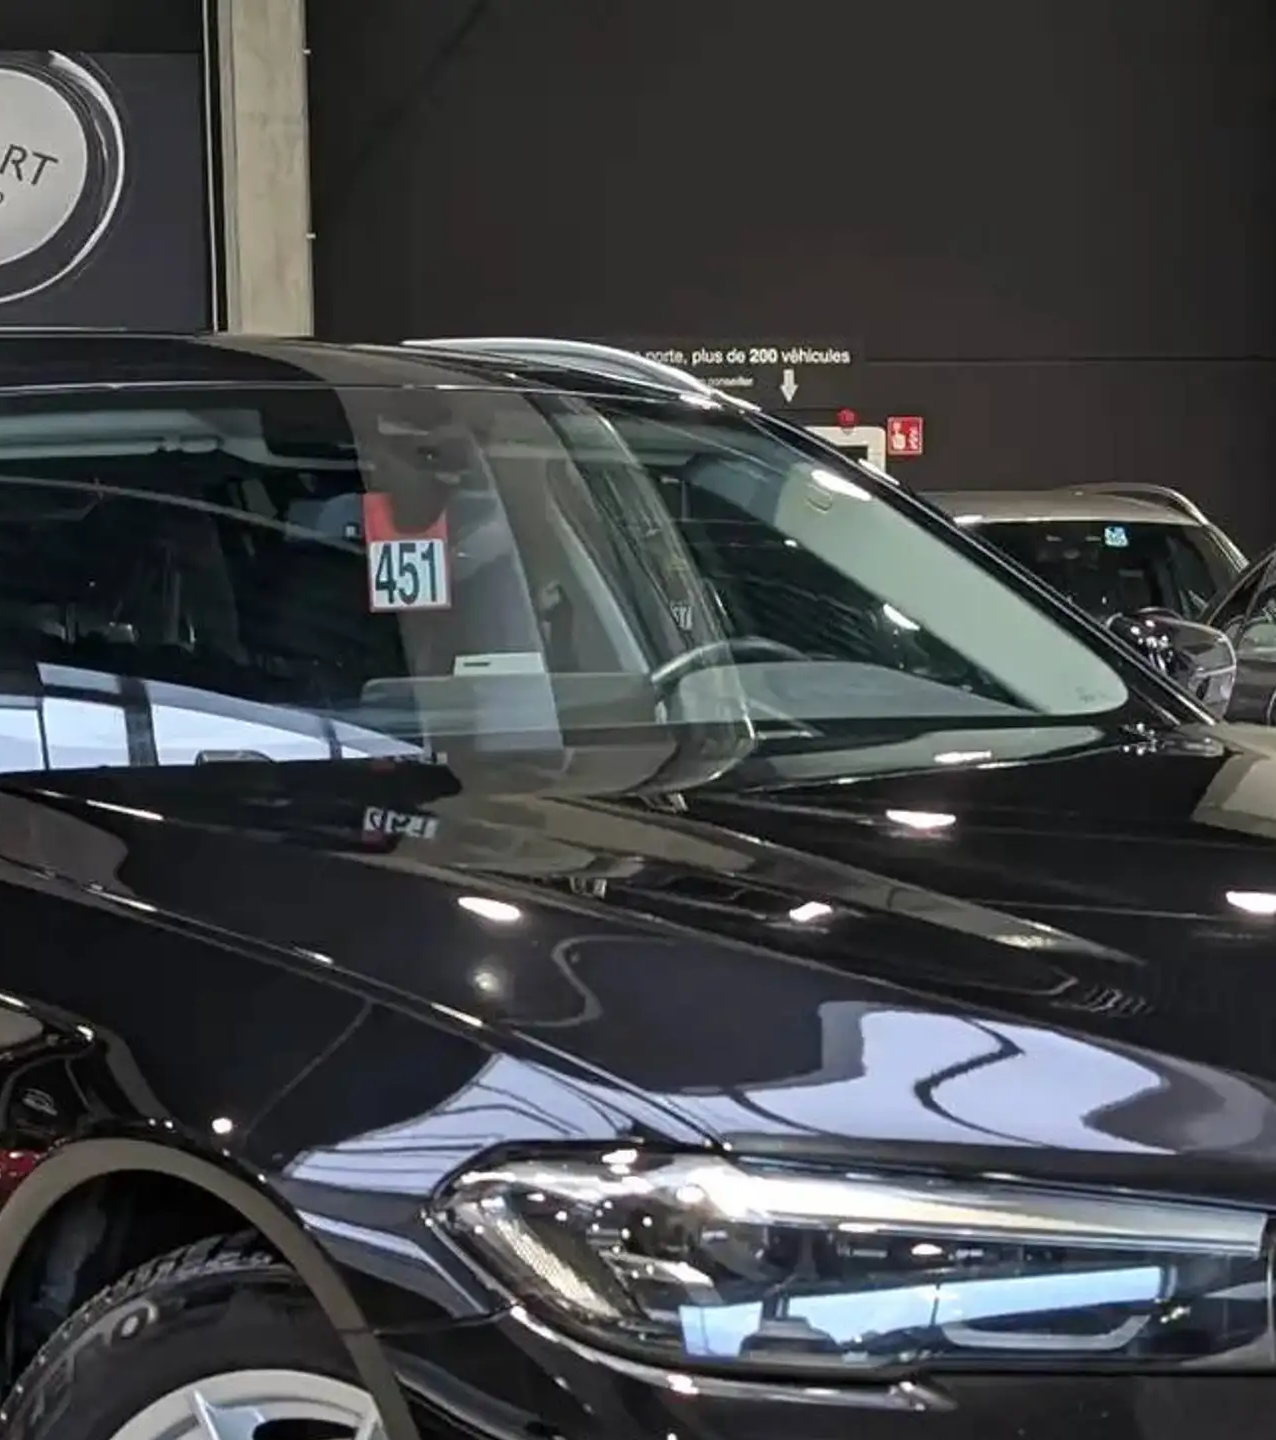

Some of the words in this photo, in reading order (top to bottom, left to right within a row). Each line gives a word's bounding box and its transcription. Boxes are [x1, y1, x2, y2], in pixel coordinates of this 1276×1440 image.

[692, 348, 722, 366] plus
[727, 348, 745, 363] de
[750, 348, 777, 363] 200
[781, 347, 851, 364] véhicules
[375, 541, 438, 605] 451
